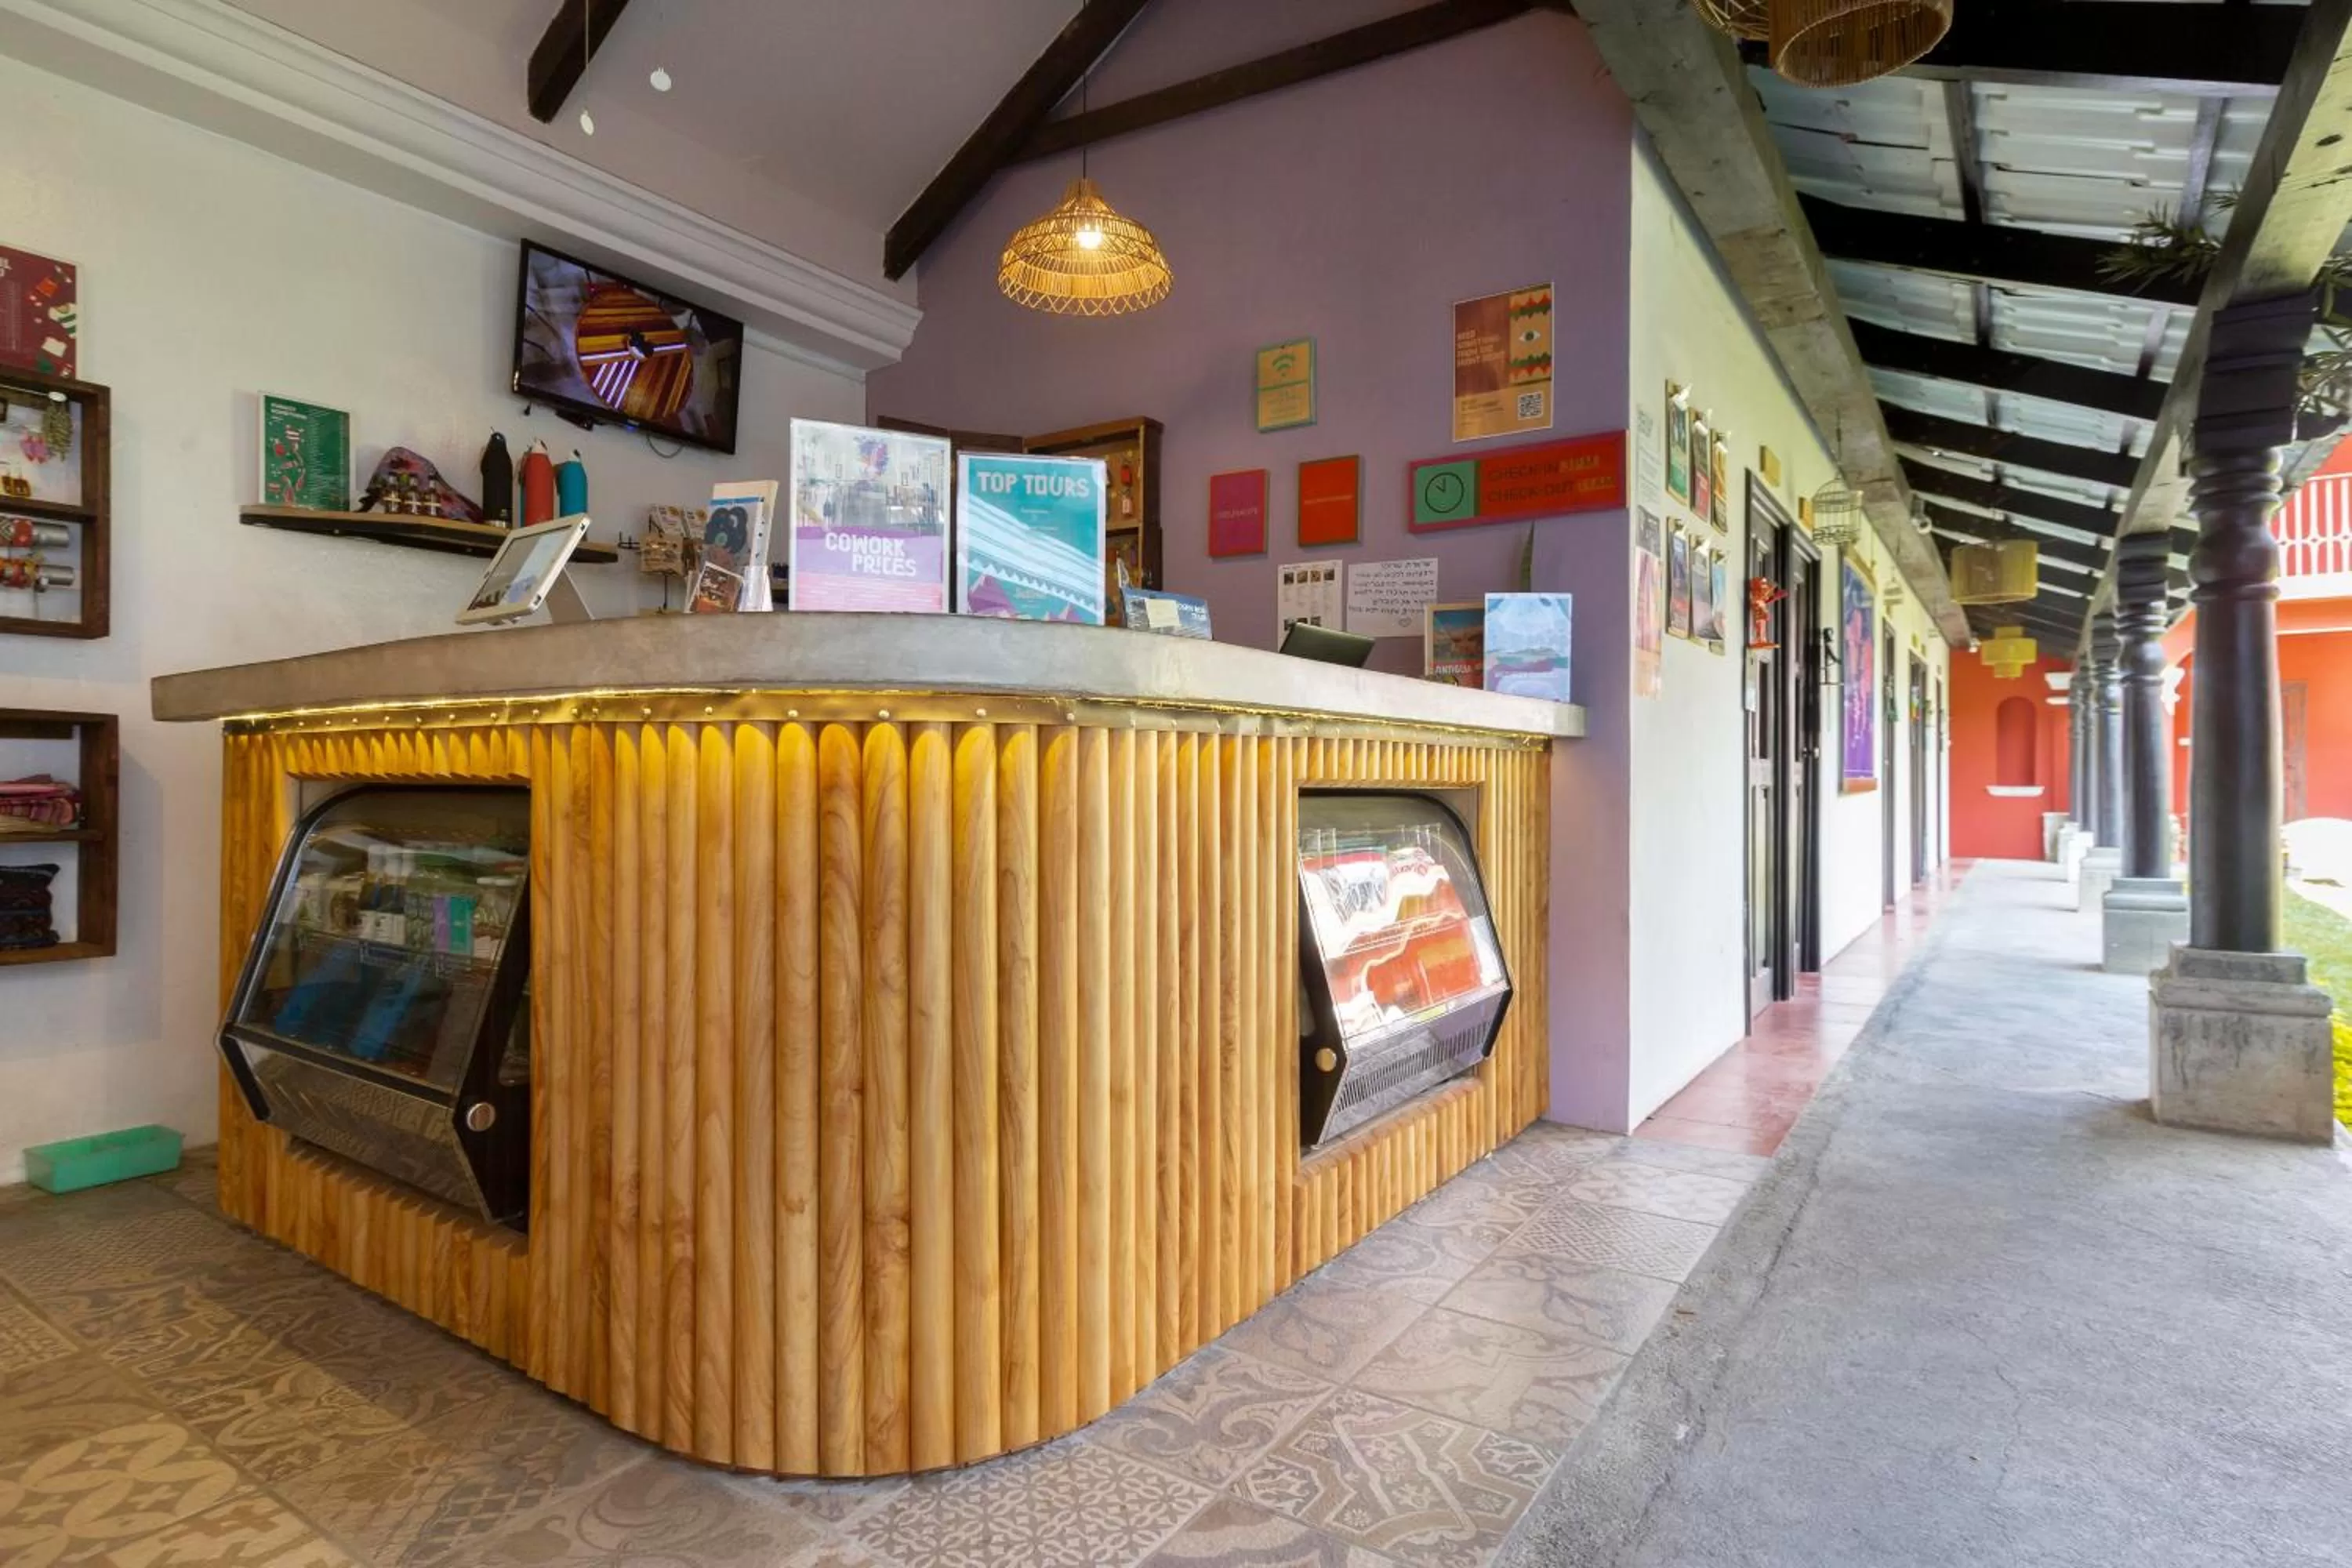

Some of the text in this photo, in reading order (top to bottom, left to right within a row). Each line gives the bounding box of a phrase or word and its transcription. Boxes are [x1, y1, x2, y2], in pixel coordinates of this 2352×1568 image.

[977, 471, 1090, 497] TOP TOURS
[825, 532, 906, 557] COWORK
[852, 554, 916, 576] PRICES
